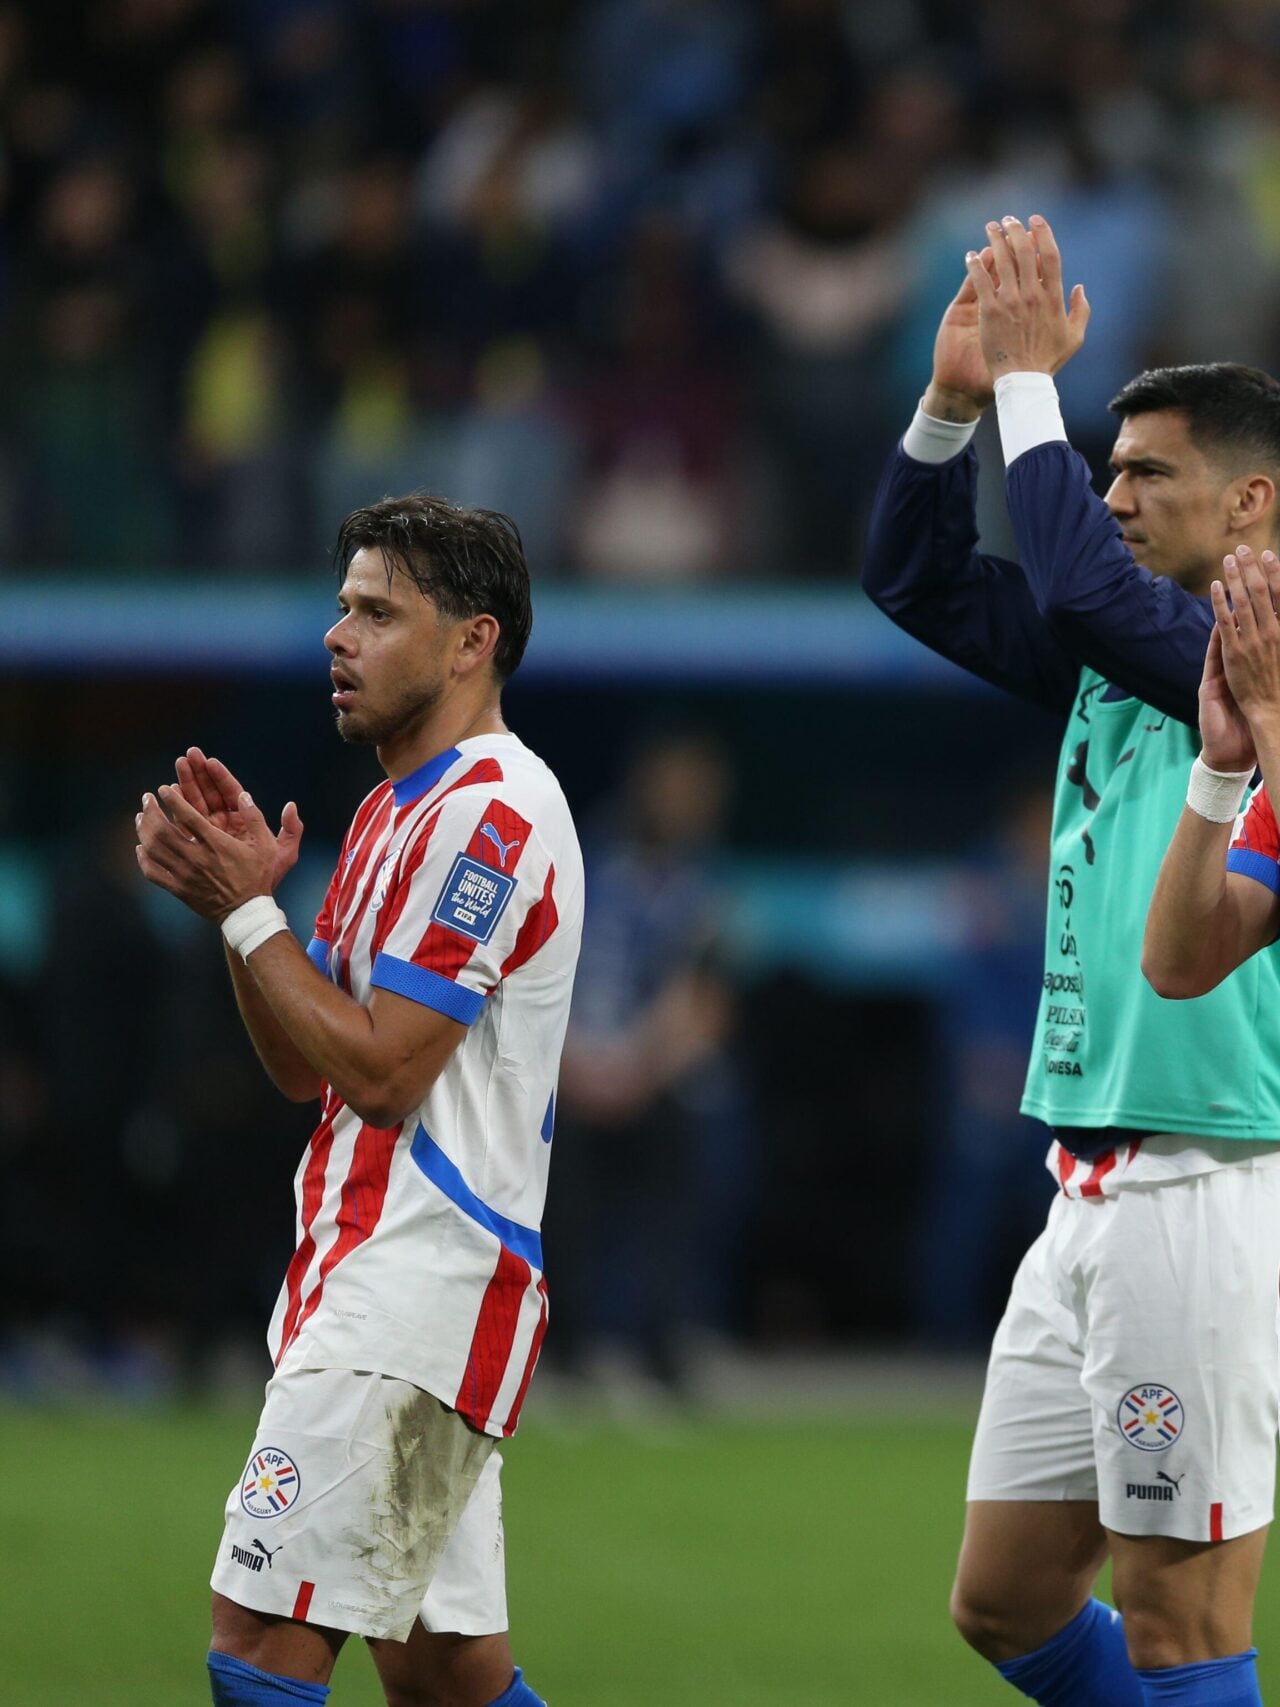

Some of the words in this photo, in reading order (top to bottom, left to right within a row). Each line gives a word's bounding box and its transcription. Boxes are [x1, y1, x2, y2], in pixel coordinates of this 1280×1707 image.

[463, 869, 499, 894] FOOTBALL
[457, 879, 496, 906] UNITES
[451, 891, 465, 905] the
[464, 897, 492, 919] World
[1048, 1060, 1083, 1077] DIESA
[1141, 1388, 1164, 1400] APF
[264, 1452, 285, 1467] APF
[1126, 1483, 1173, 1501] PUMA
[246, 1500, 272, 1515] PARAGUAY
[231, 1544, 265, 1573] PUMA
